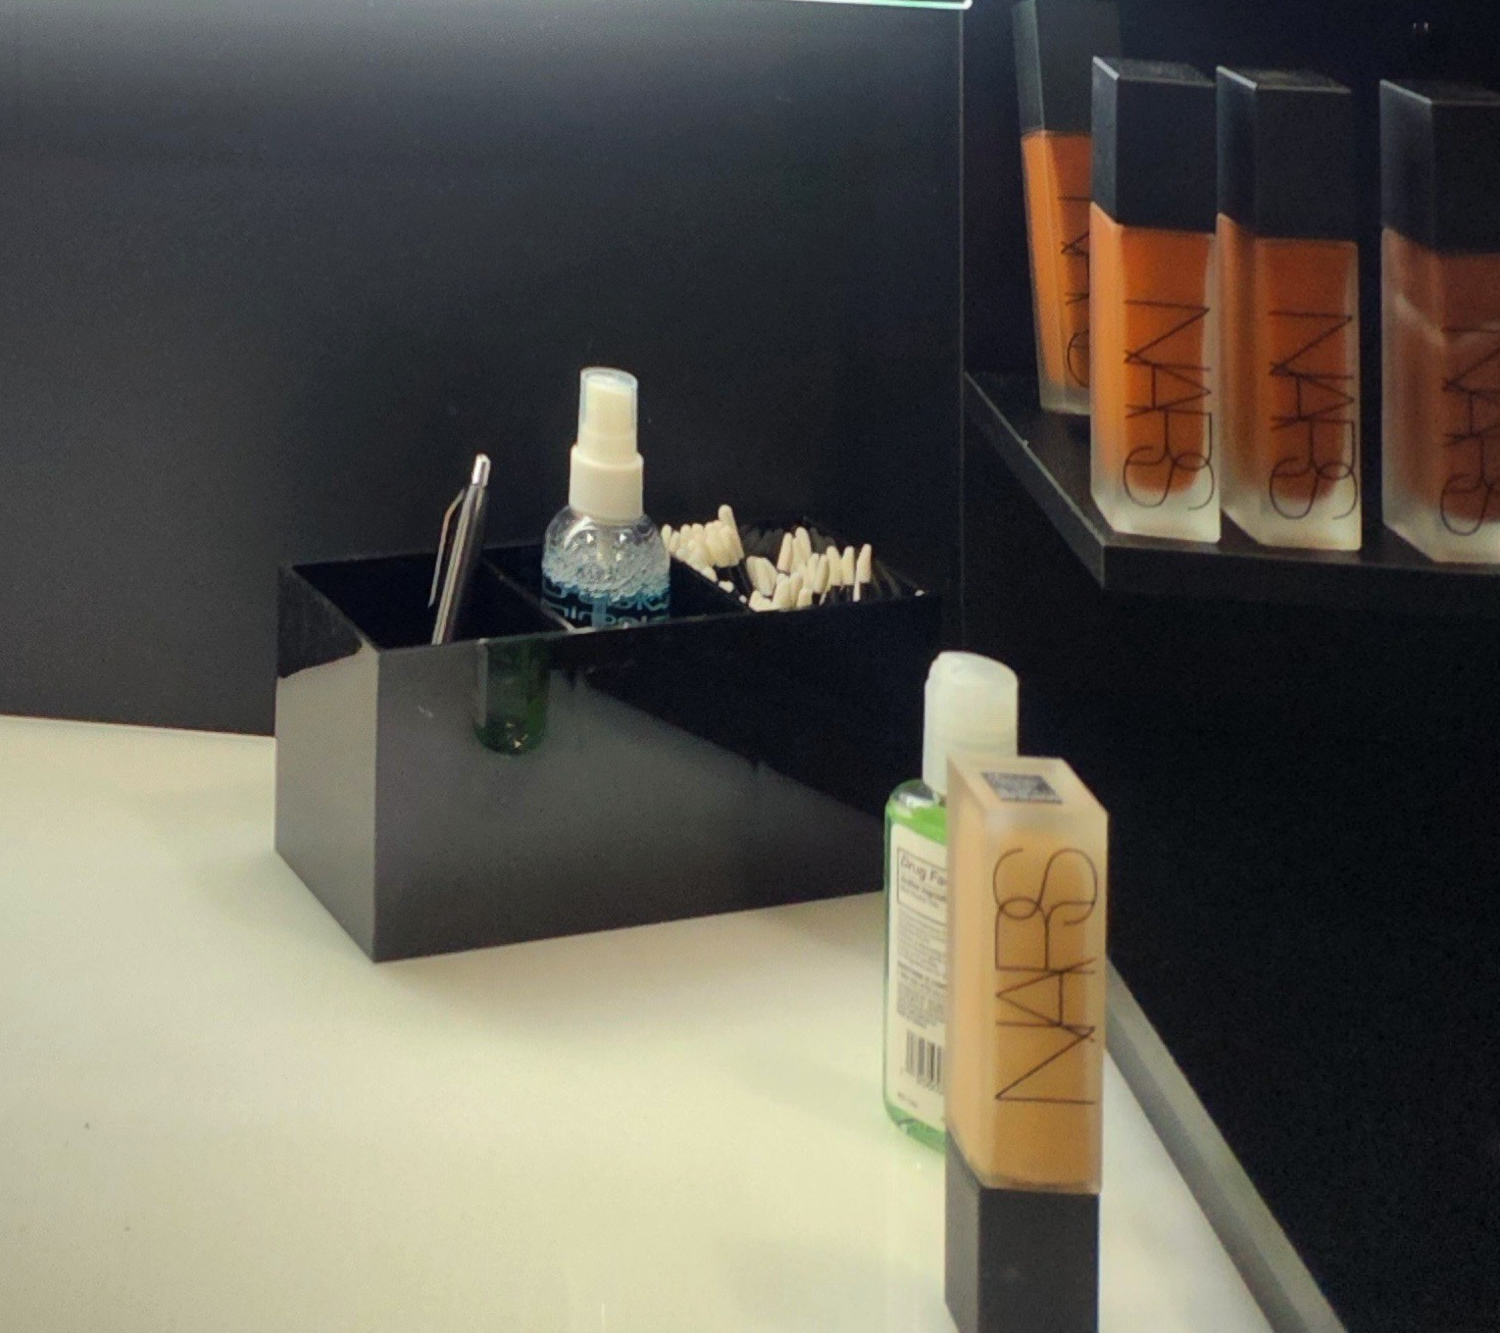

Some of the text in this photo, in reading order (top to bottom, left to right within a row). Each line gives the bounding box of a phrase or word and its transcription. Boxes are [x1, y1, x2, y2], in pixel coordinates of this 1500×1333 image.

[1123, 299, 1215, 511] NARS
[1269, 309, 1358, 519] NARS
[993, 847, 1099, 1106] NARS
